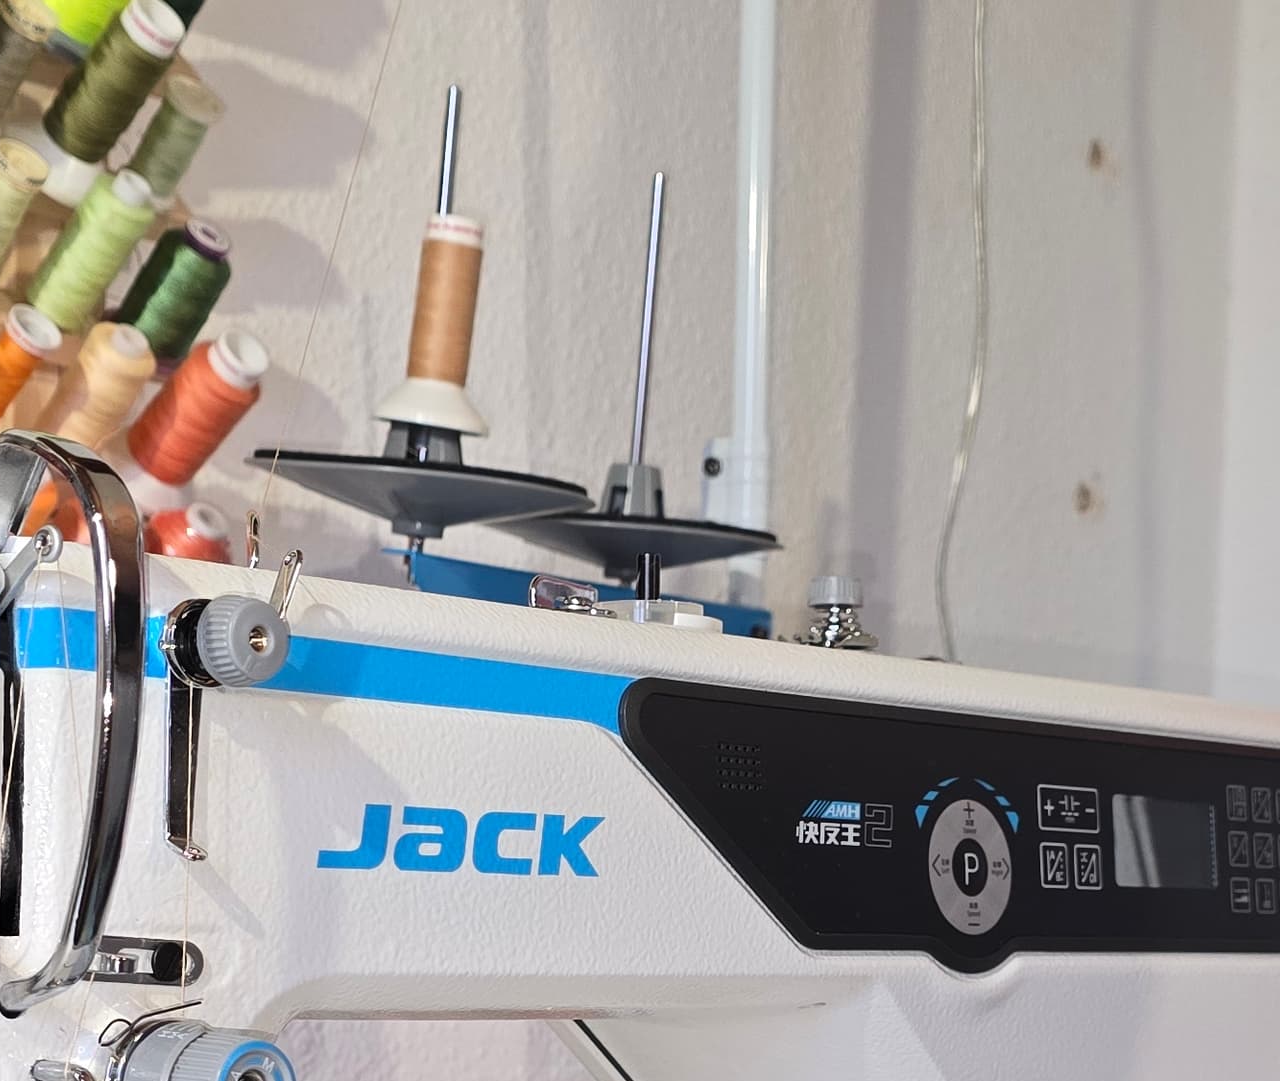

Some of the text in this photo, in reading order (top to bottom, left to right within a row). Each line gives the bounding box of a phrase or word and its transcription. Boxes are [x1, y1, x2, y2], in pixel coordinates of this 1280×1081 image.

[825, 803, 860, 819] AMH
[796, 820, 861, 847] 快反王
[963, 852, 979, 886] P
[262, 1057, 275, 1073] M
